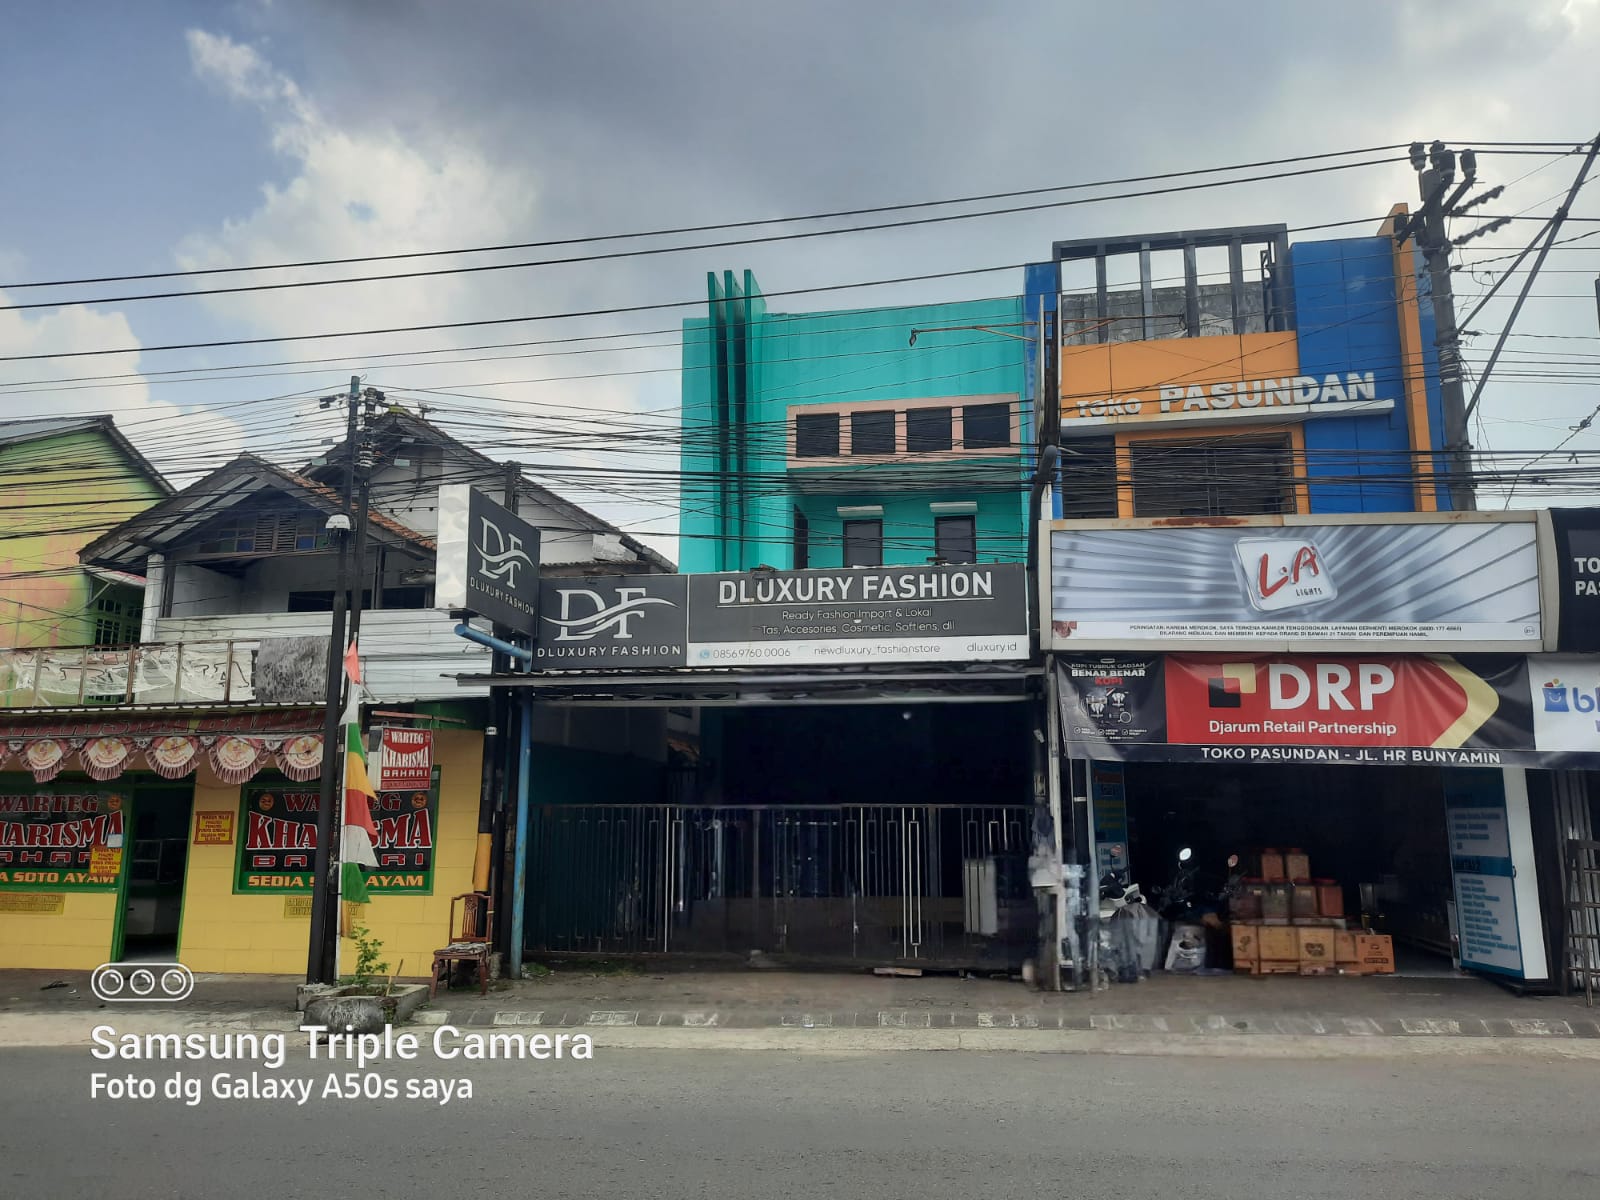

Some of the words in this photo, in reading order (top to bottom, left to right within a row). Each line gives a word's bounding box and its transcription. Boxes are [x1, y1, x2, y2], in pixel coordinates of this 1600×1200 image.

[1077, 398, 1142, 417] TOKO
[1160, 372, 1377, 413] PASUNDAN
[719, 577, 853, 604] DLUXURY
[862, 571, 993, 600] FASHION
[1296, 587, 1322, 597] LIGHTS
[470, 576, 504, 601] DLUXURY
[505, 593, 535, 616] FASHION
[782, 610, 815, 623] Ready
[817, 608, 856, 619] Fashion
[858, 607, 892, 620] Import
[895, 608, 903, 618] &
[905, 608, 932, 617] Lokal
[762, 625, 781, 635] Tas,
[537, 647, 606, 657] DLUXURY
[611, 645, 681, 656] FASHION
[966, 642, 1017, 653] dluxury.id
[1071, 669, 1107, 677] BENAR
[1109, 669, 1146, 677] BENAR
[1095, 677, 1123, 685] KOPI
[1268, 662, 1395, 711] DRP
[1209, 720, 1261, 735] Djarum
[1263, 721, 1305, 733] Retail
[1308, 722, 1397, 737] Partnership
[391, 731, 424, 745] WARTEG
[382, 744, 429, 768] KHARISMA
[1201, 747, 1246, 759] TOKO
[1250, 748, 1339, 760] PASUNDAN
[1355, 750, 1378, 761] JL.
[1383, 750, 1406, 761] HR
[1412, 750, 1500, 763] BUNYAMIN
[383, 769, 428, 777] BAHARI
[13, 872, 59, 883] SOTO
[248, 875, 304, 888] SEDIA
[366, 875, 424, 887] AYAM
